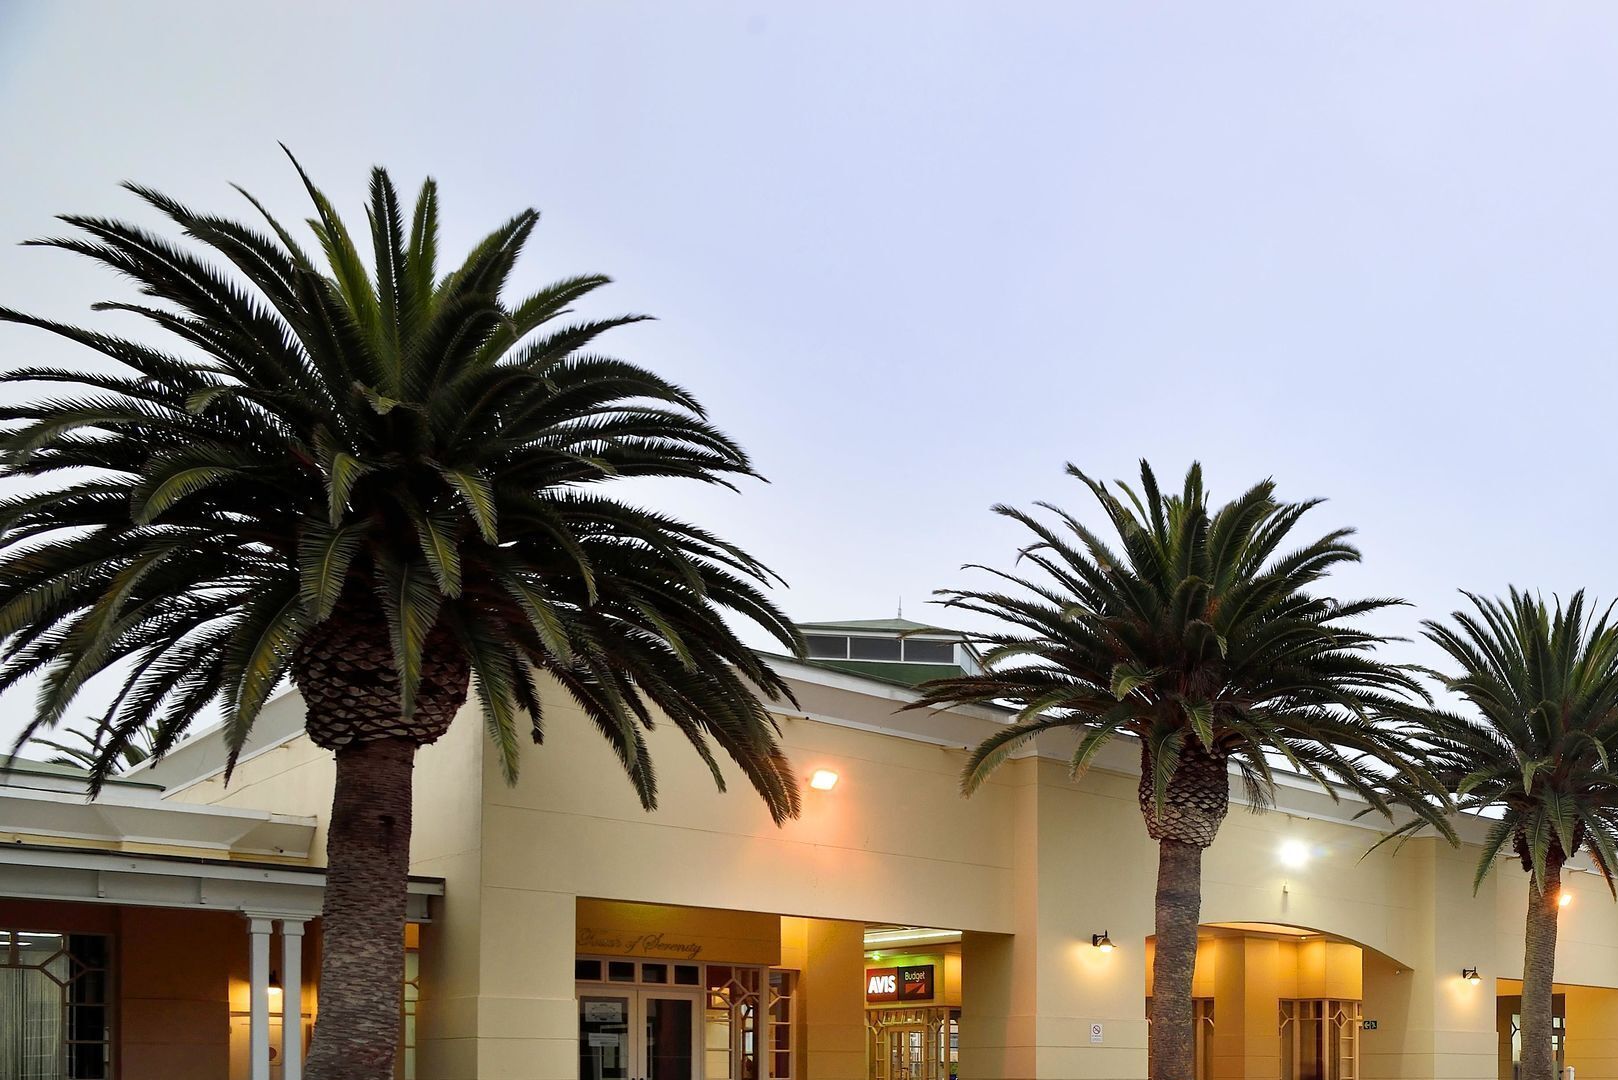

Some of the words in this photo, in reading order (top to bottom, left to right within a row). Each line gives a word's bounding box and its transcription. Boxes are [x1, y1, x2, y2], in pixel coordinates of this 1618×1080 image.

[624, 935, 643, 954] of
[642, 932, 702, 960] Serenity
[867, 975, 896, 994] AVIS
[904, 971, 925, 982] Budget
